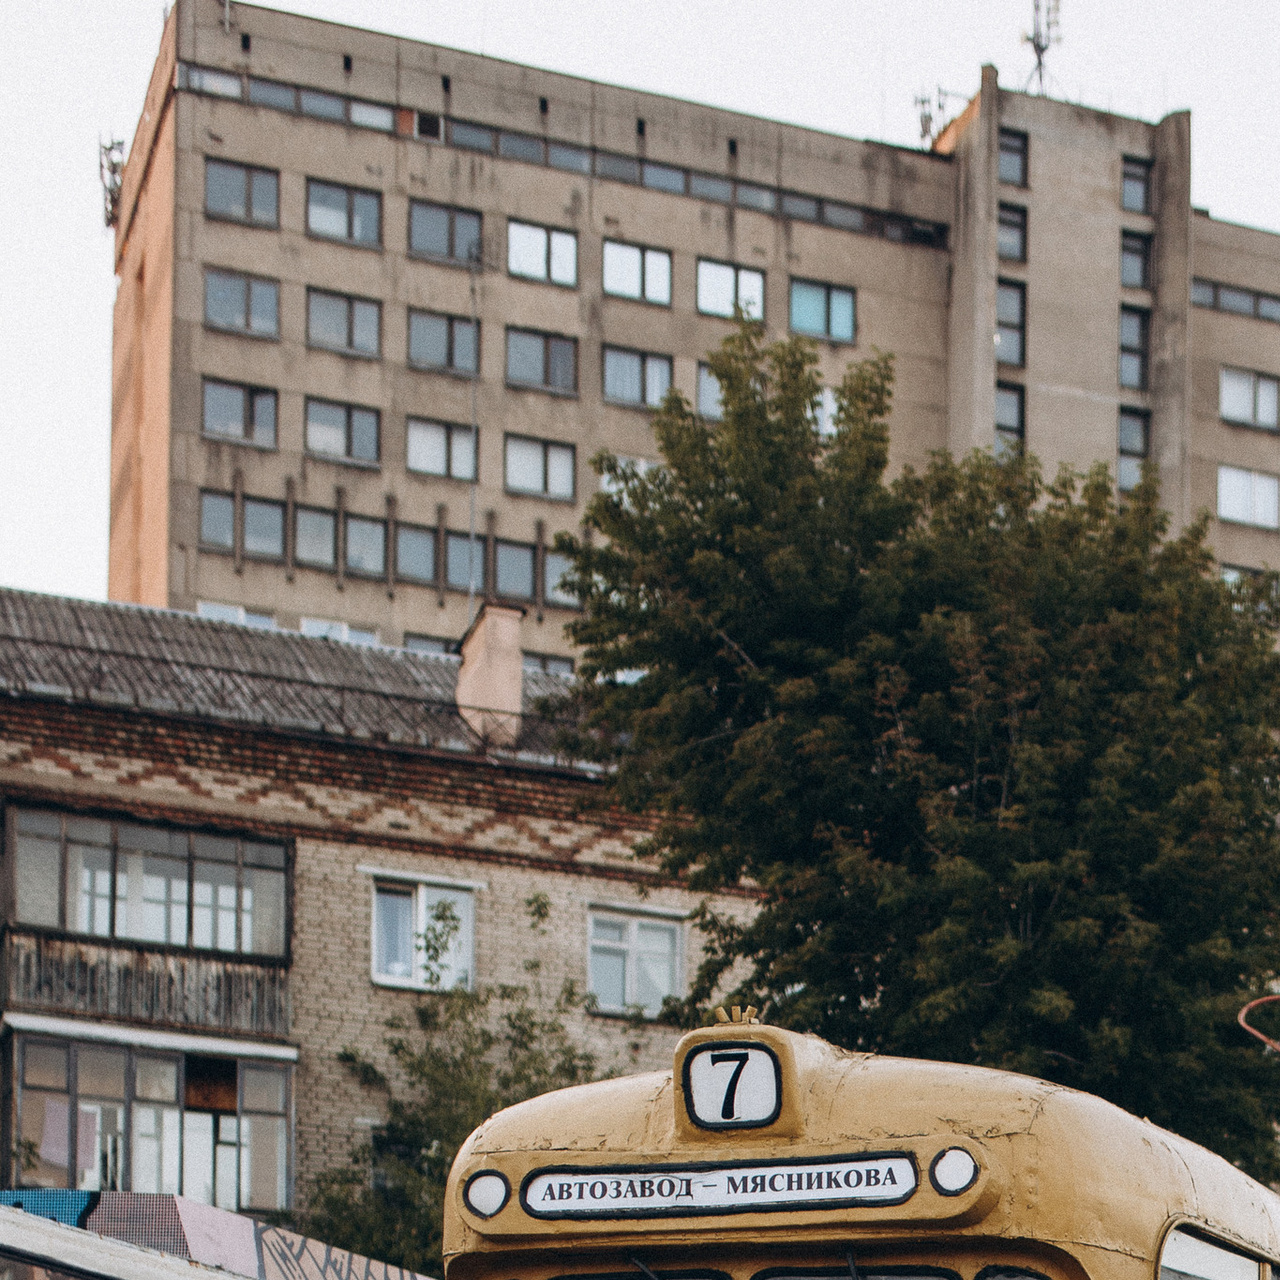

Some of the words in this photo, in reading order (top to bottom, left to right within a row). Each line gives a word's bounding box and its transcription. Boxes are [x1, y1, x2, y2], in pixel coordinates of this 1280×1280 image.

[711, 1052, 749, 1119] 7
[541, 1177, 694, 1201] АВТОЗАВОД
[726, 1167, 898, 1195] МЯСНИКОВА
